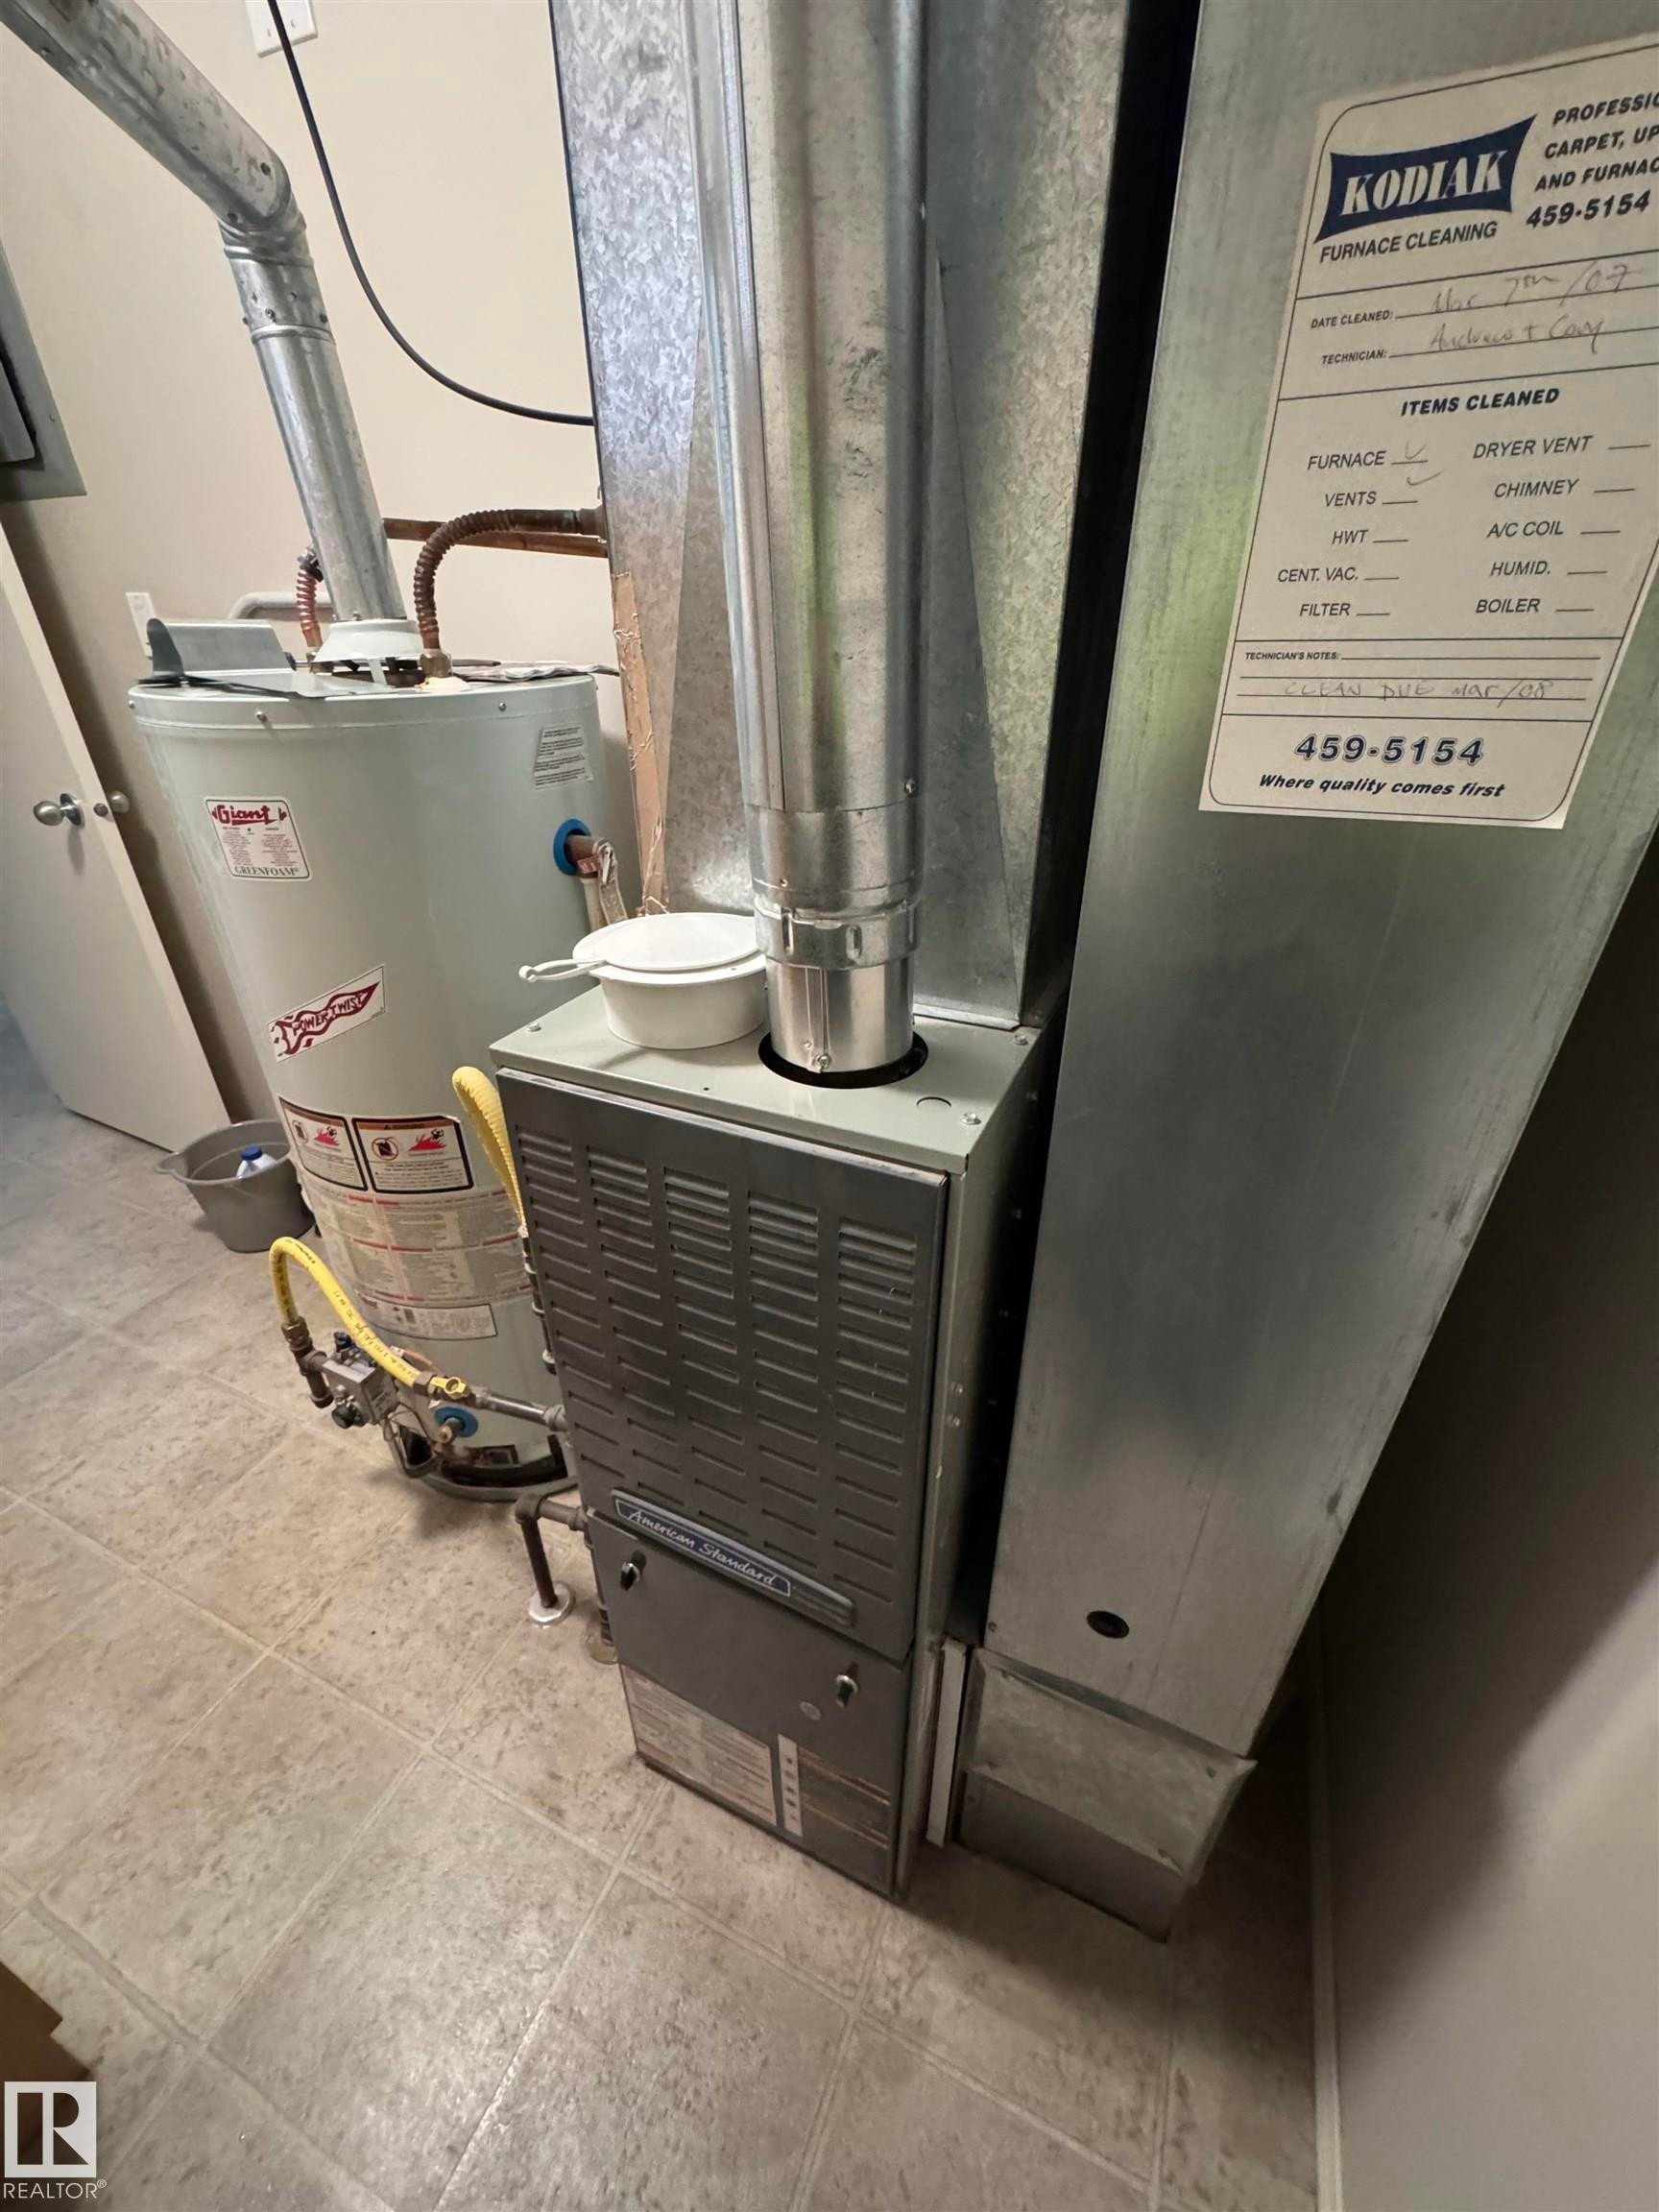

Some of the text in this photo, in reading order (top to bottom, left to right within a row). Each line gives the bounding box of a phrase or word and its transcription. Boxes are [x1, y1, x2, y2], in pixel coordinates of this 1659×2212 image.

[1545, 131, 1624, 159] CARPET,
[1340, 150, 1508, 216] KODIAK
[1534, 156, 1659, 192] AND FURNAC
[1320, 221, 1498, 263] FURNACE CLEANING
[1310, 310, 1393, 328] DATE CLEANED:
[1321, 349, 1387, 365] TECHNICIAN:
[1401, 388, 1560, 417] ITEMS CLEANED
[1473, 435, 1594, 459] DRYER VENT
[1308, 451, 1386, 470] FURNACE
[1494, 479, 1579, 498] CHIMNEY
[1325, 492, 1377, 508] VENTS
[1332, 530, 1368, 545] HWT
[1487, 521, 1564, 539] A/C COIL
[1278, 567, 1359, 584] CENT. VAC.
[1490, 562, 1551, 576] HUMID.
[1300, 603, 1351, 617] FILTER
[1476, 599, 1540, 614] BOILER
[1245, 652, 1340, 661] TECHNICIAN'S NOTES:
[1285, 682, 1361, 697] CLEAN
[1294, 733, 1484, 766] 459-5154
[1259, 774, 1505, 798] Where quality comes first
[217, 805, 270, 825] Giant
[292, 993, 363, 1036] POWER TWIST
[627, 1510, 780, 1586] American Standard
